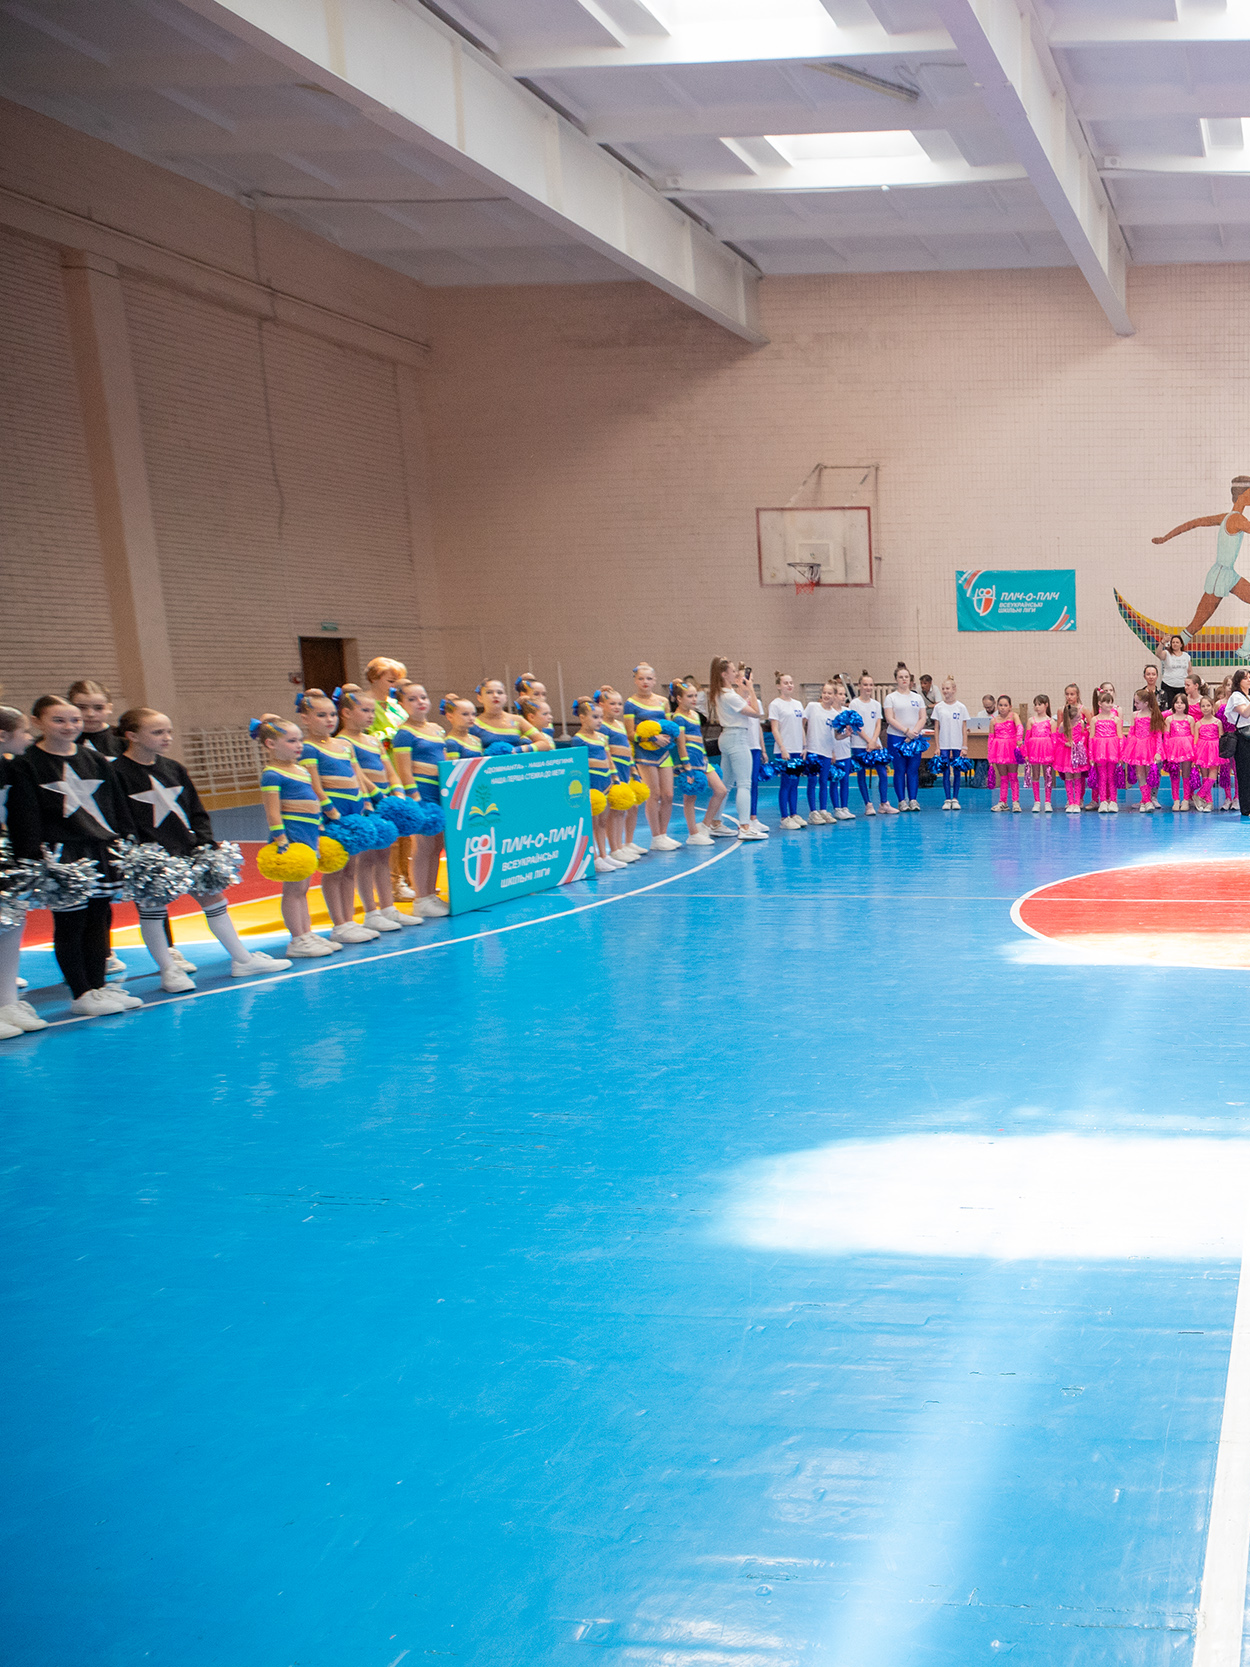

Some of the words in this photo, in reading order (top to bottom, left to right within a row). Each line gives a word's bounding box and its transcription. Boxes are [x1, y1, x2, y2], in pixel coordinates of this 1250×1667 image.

[1000, 592, 1060, 601] ПЛІЧ-О-ПЛІЧ
[501, 825, 576, 854] ПЛІЧ-О-ПЛІЧ
[502, 850, 559, 871] ВСЕУКРАЇНСЬКІ
